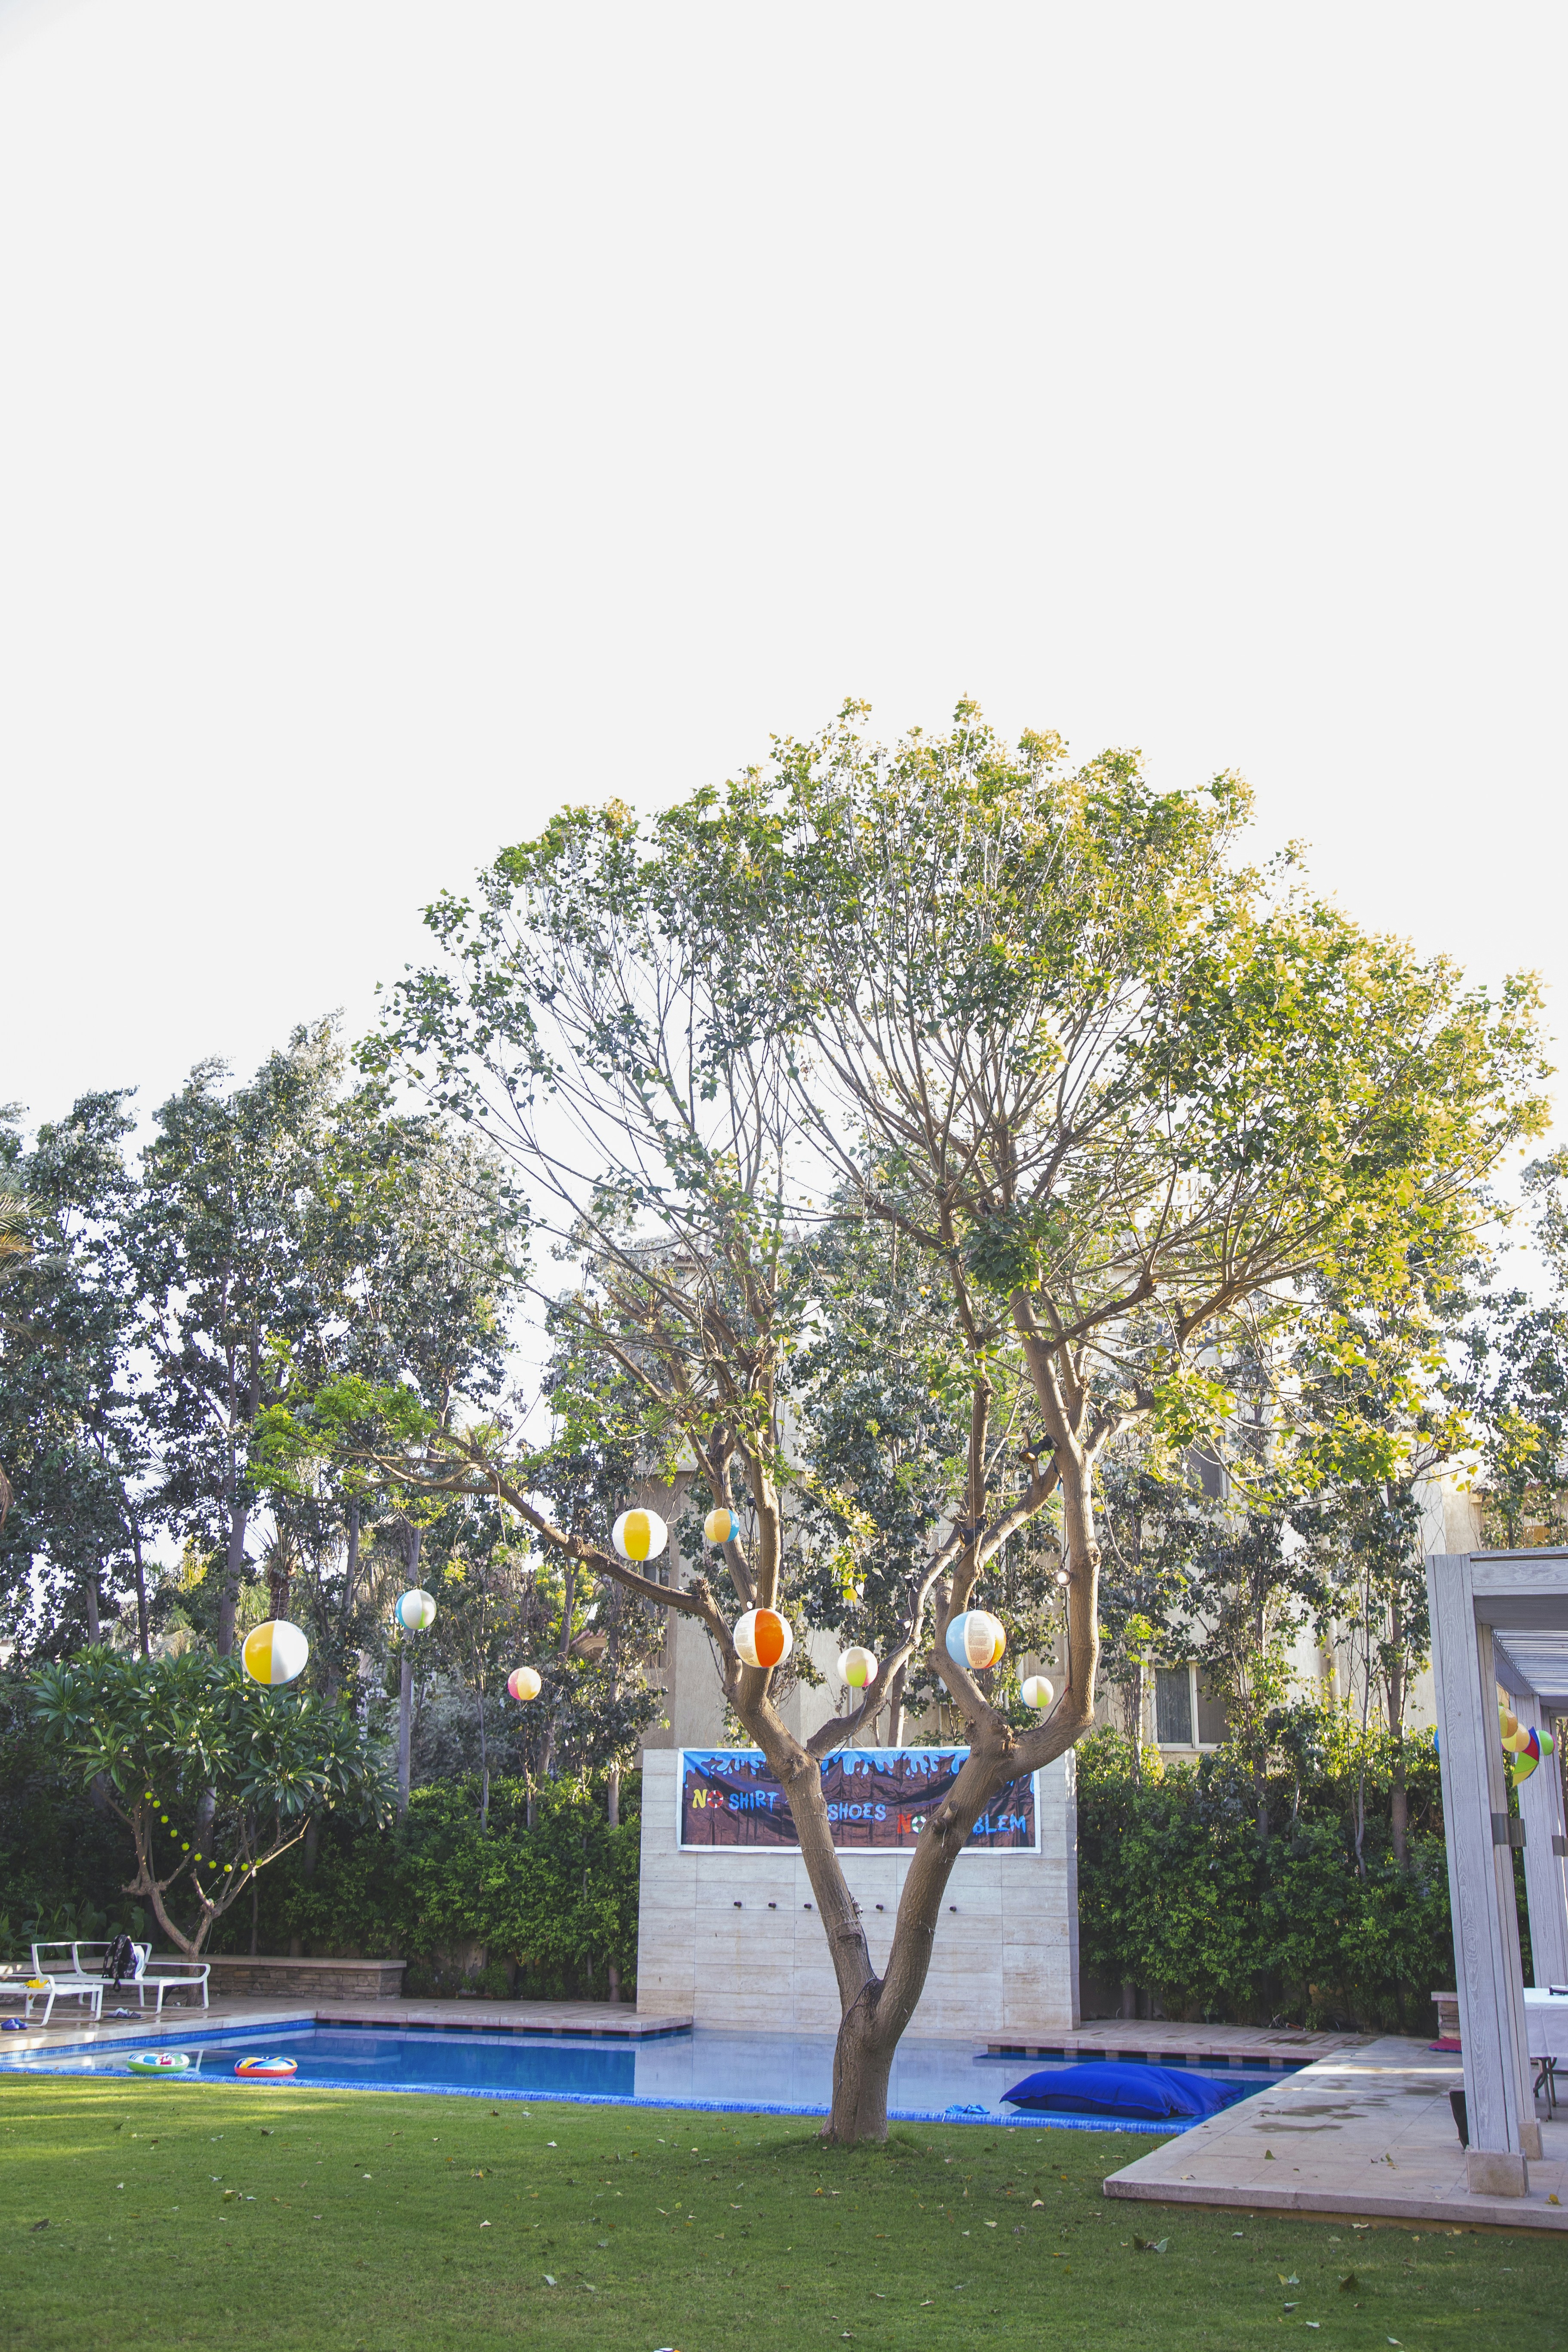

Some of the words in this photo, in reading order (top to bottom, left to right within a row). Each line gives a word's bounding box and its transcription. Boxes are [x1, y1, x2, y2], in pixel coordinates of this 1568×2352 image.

[692, 1788, 724, 1809] NO
[729, 1789, 779, 1813] SHIRT
[827, 1802, 887, 1822] SHOES
[972, 1813, 1026, 1836] BLEM
